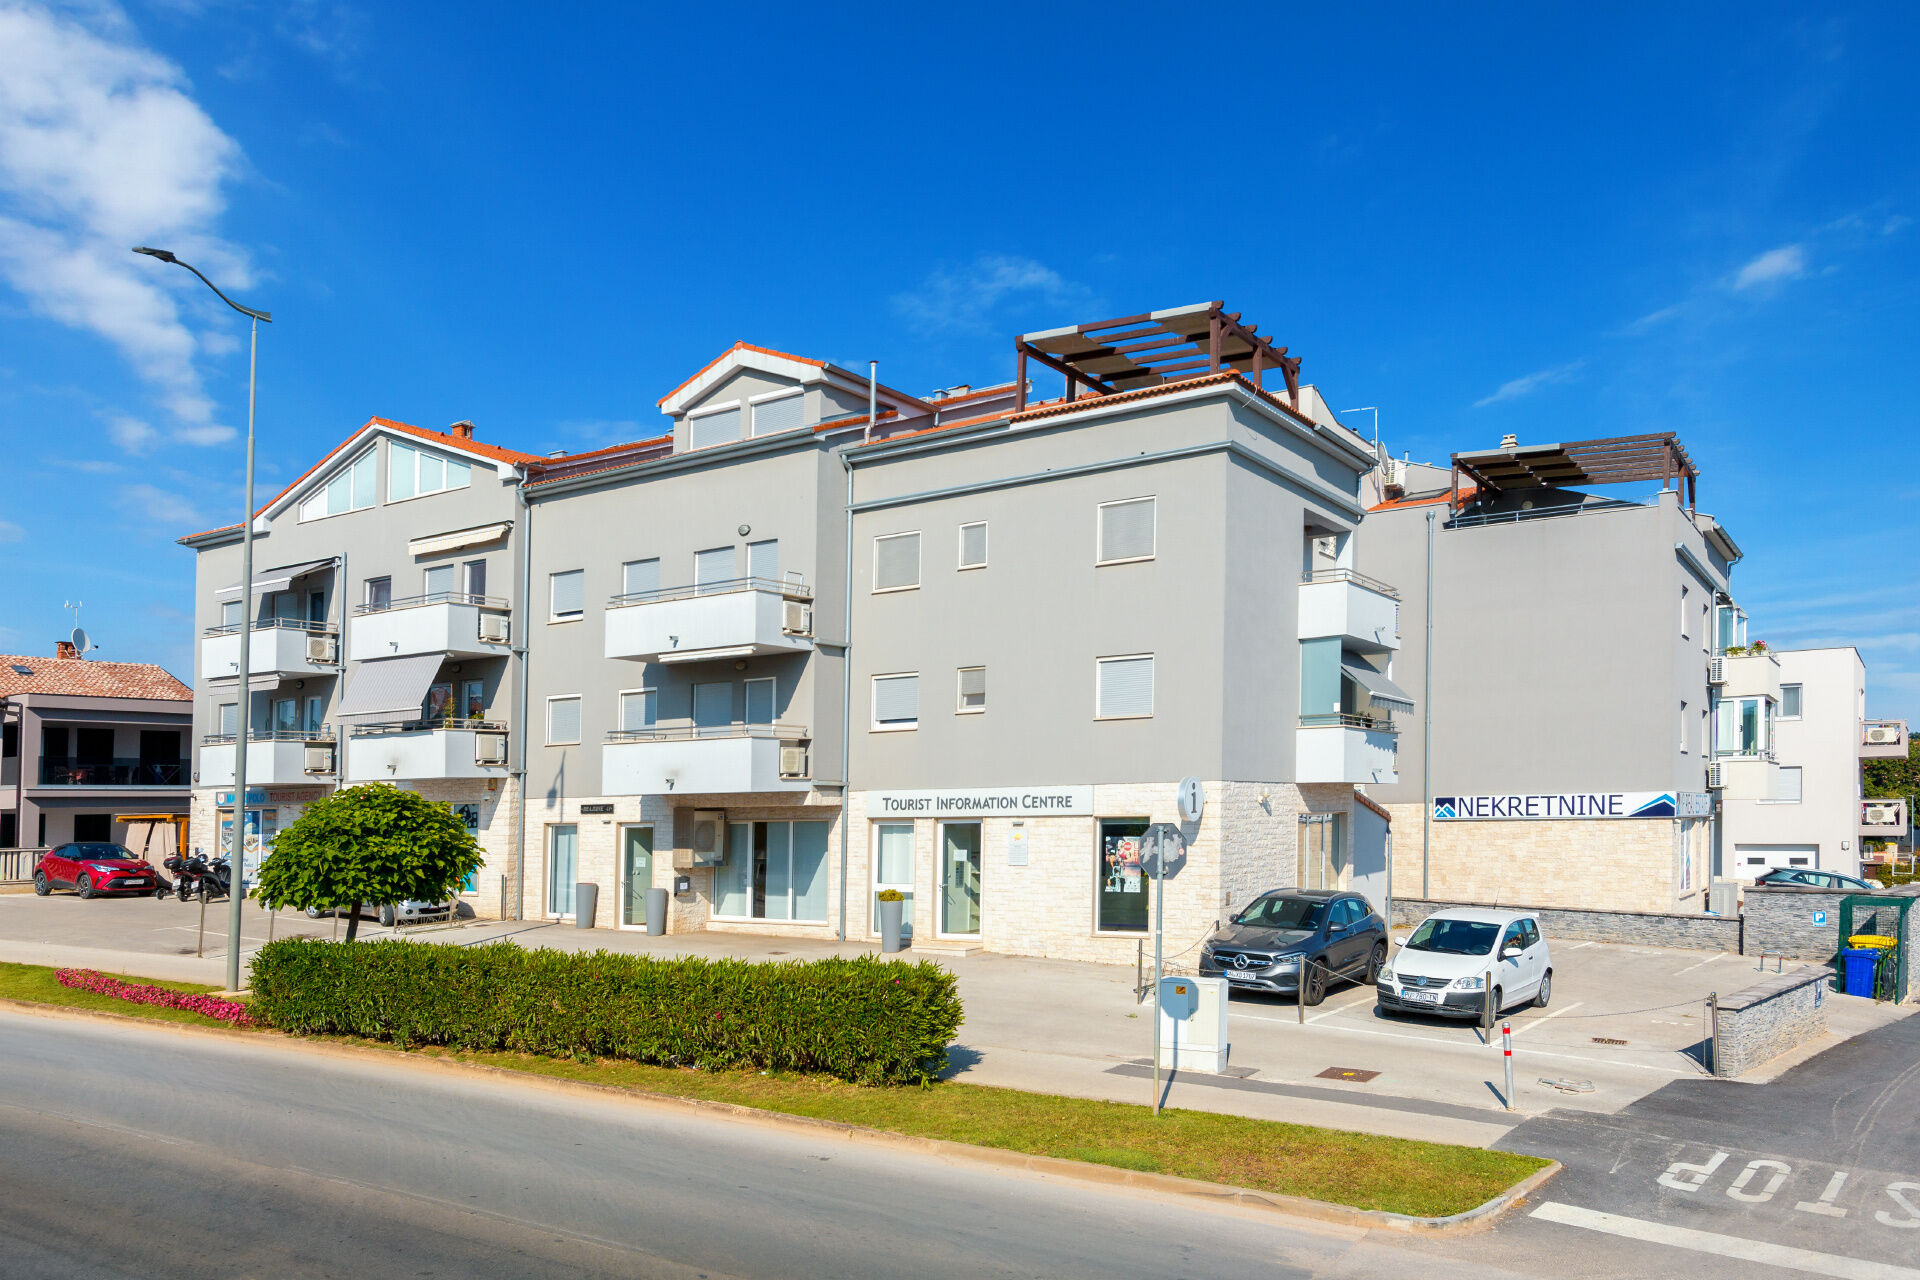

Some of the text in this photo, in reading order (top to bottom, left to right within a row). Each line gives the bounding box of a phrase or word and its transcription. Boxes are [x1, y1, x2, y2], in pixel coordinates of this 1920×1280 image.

[269, 791, 296, 802] TOURIST
[296, 791, 322, 801] AGENCY
[882, 794, 1073, 811] TOURIST INFORMATION CENTRE
[1458, 794, 1624, 817] NEKRETNINE
[1815, 913, 1824, 922] P
[1656, 1151, 1920, 1229] STOP
